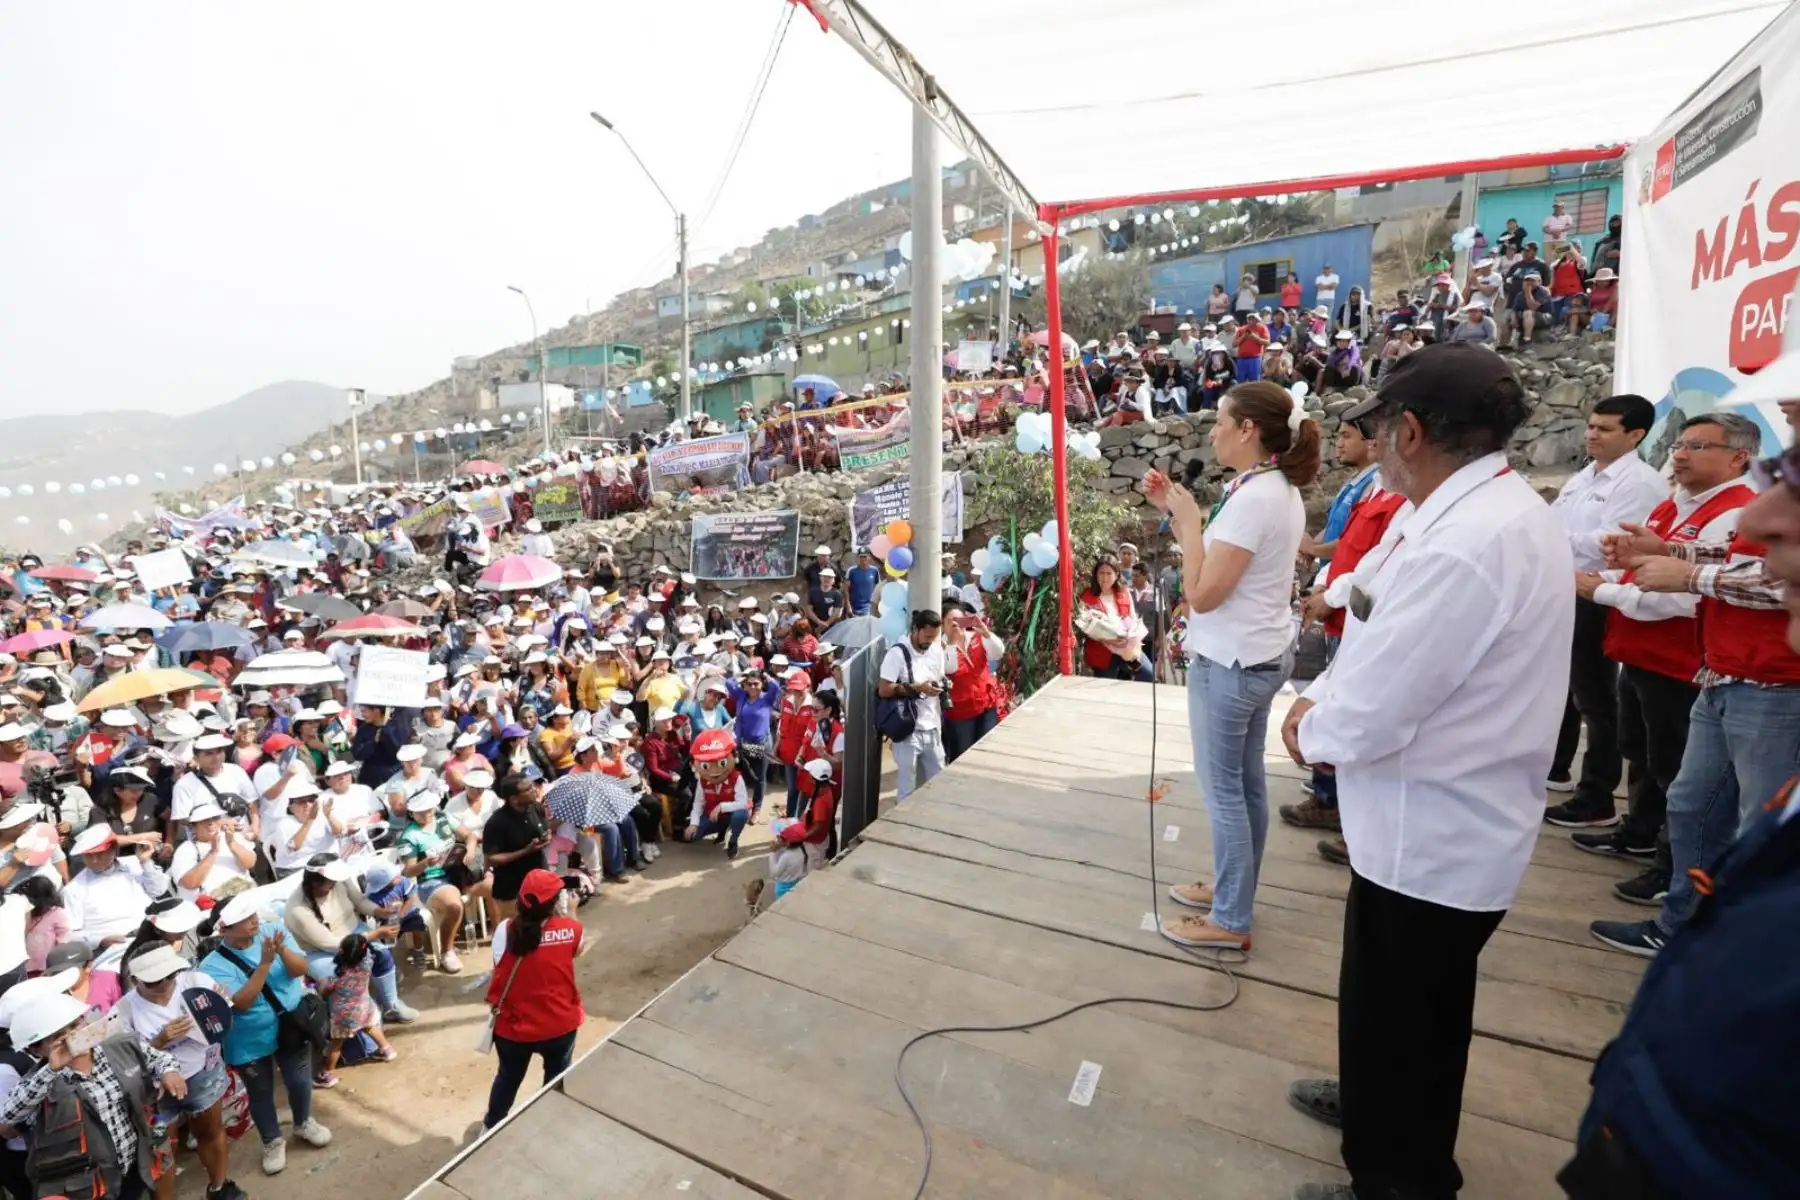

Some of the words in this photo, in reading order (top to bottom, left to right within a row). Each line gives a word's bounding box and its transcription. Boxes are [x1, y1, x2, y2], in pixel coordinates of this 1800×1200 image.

[1708, 98, 1757, 138] Construcción
[1677, 144, 1717, 176] Saneamiento
[1691, 177, 1800, 291] MÁS
[541, 928, 575, 942] ENDA
